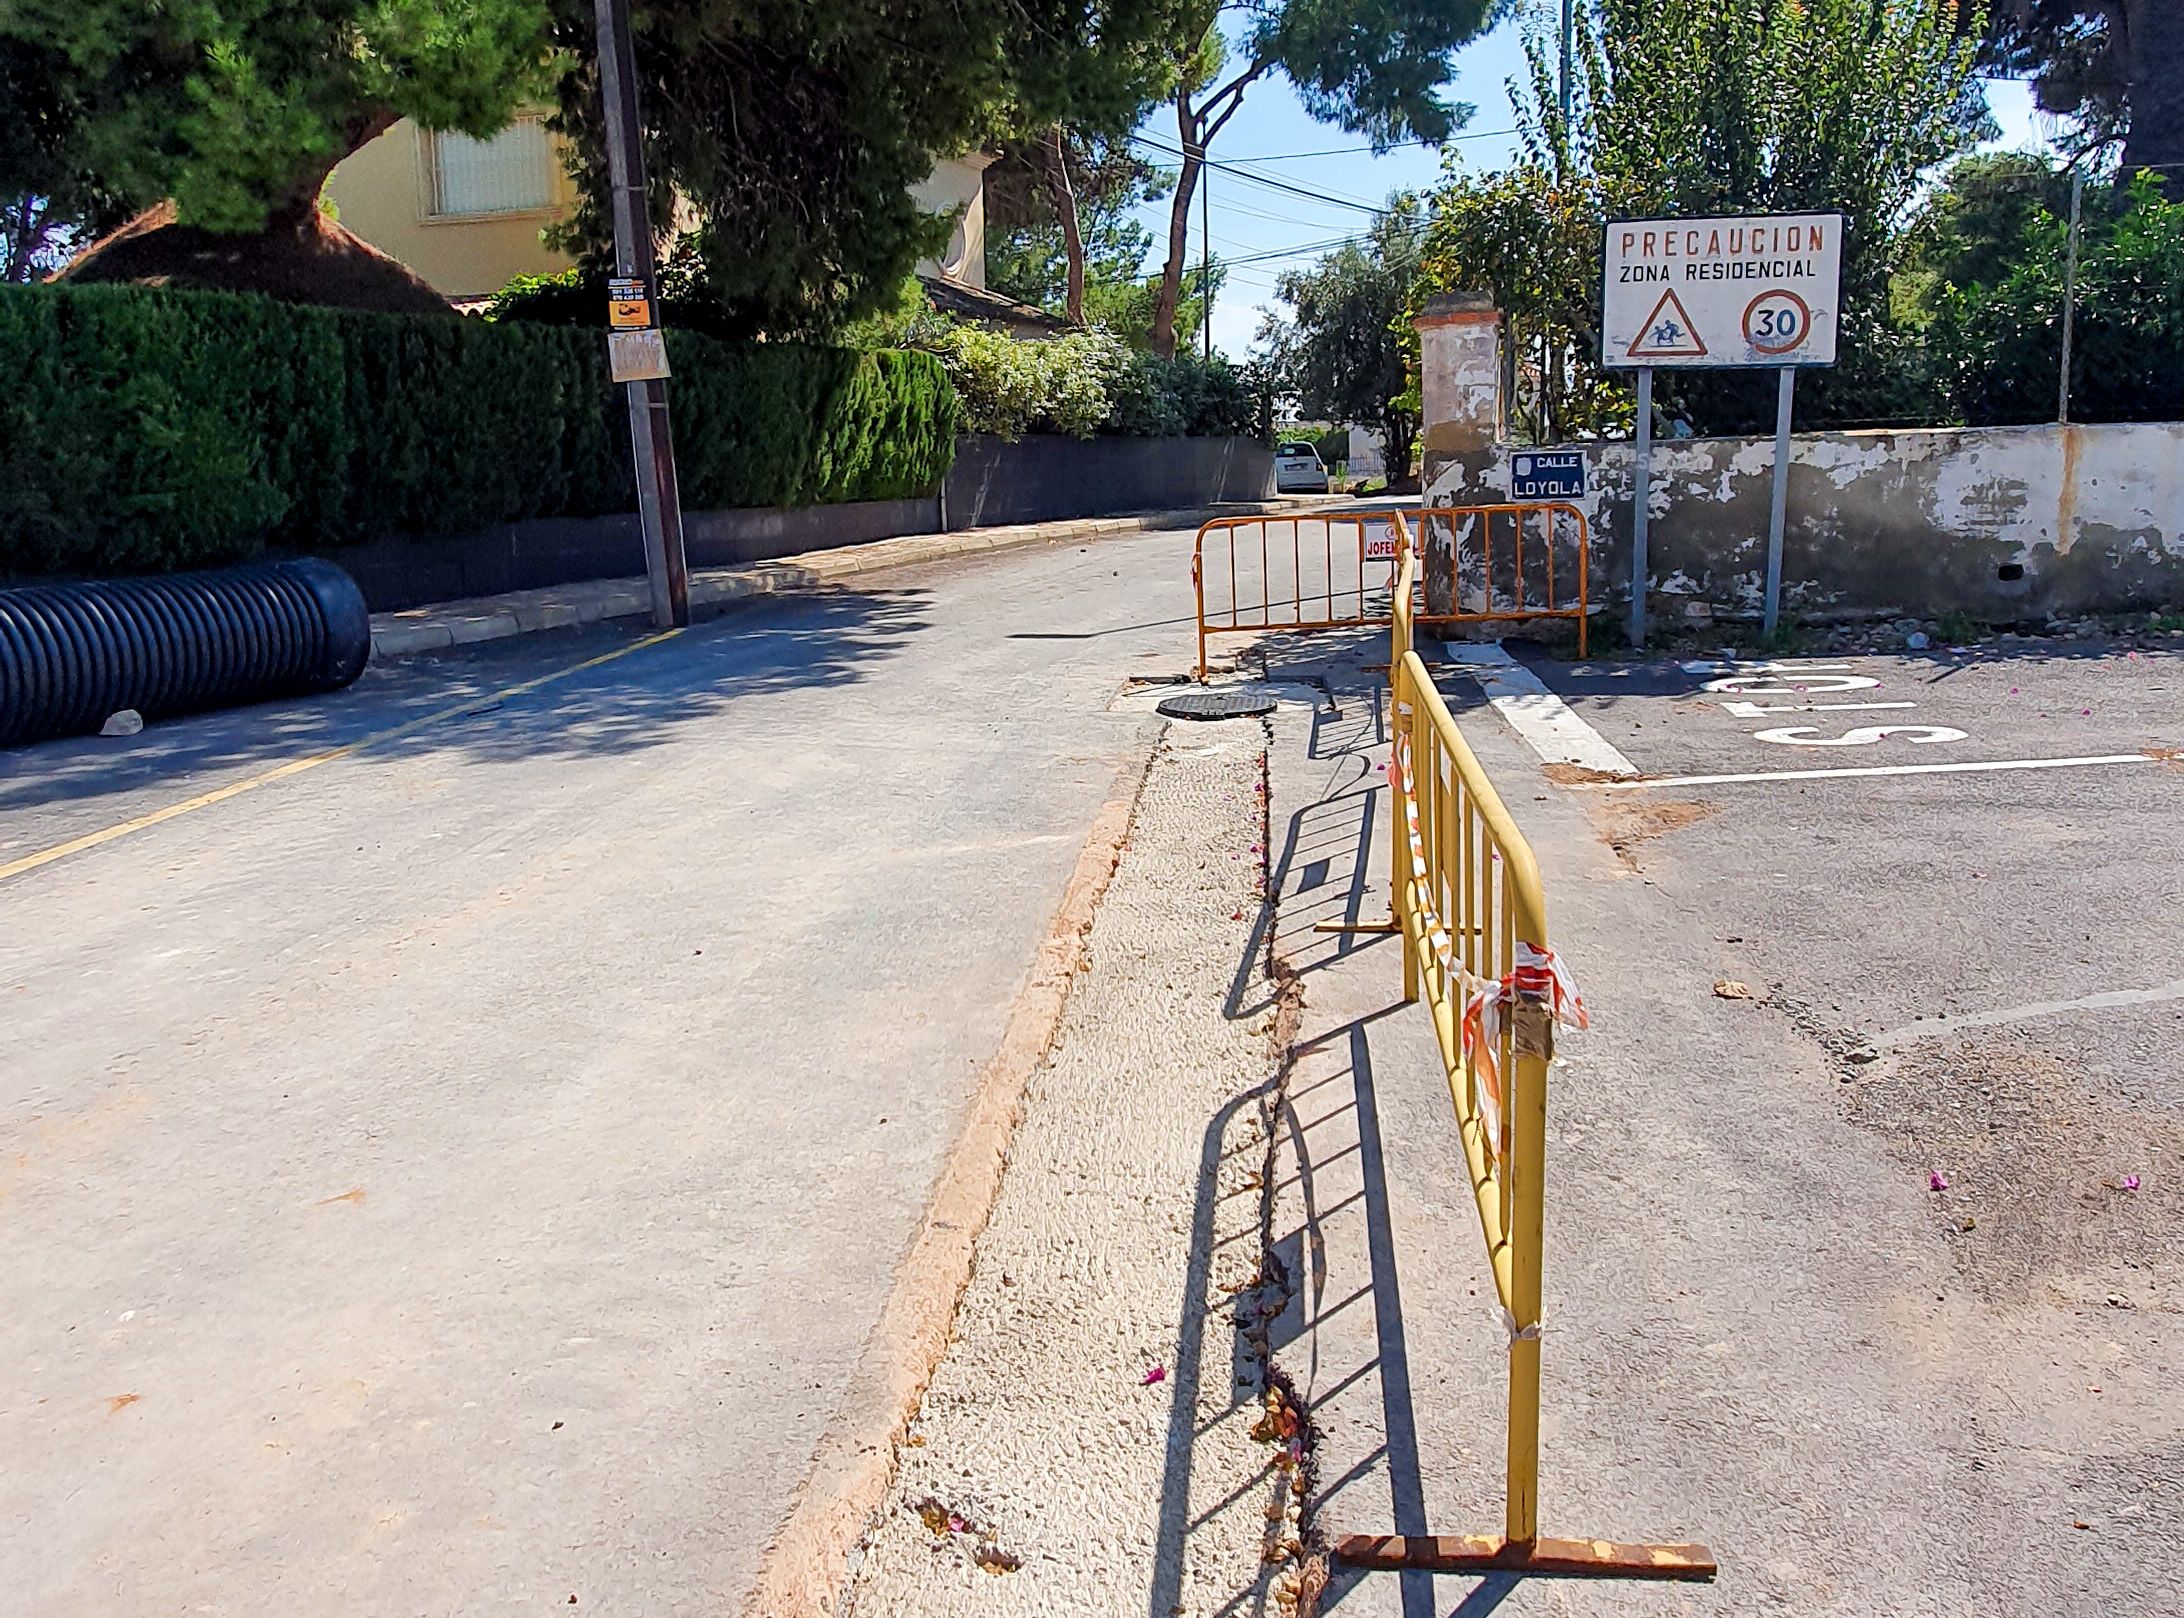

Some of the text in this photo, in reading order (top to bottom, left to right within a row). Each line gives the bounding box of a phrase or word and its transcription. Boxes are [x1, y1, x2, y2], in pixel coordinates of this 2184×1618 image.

[1621, 225, 1824, 258] PRECAUCION
[1619, 259, 1816, 283] ZONA RESIDENCIAL
[1756, 309, 1796, 337] 30
[1537, 457, 1578, 468] CALLE
[1514, 481, 1581, 495] LOYOLA
